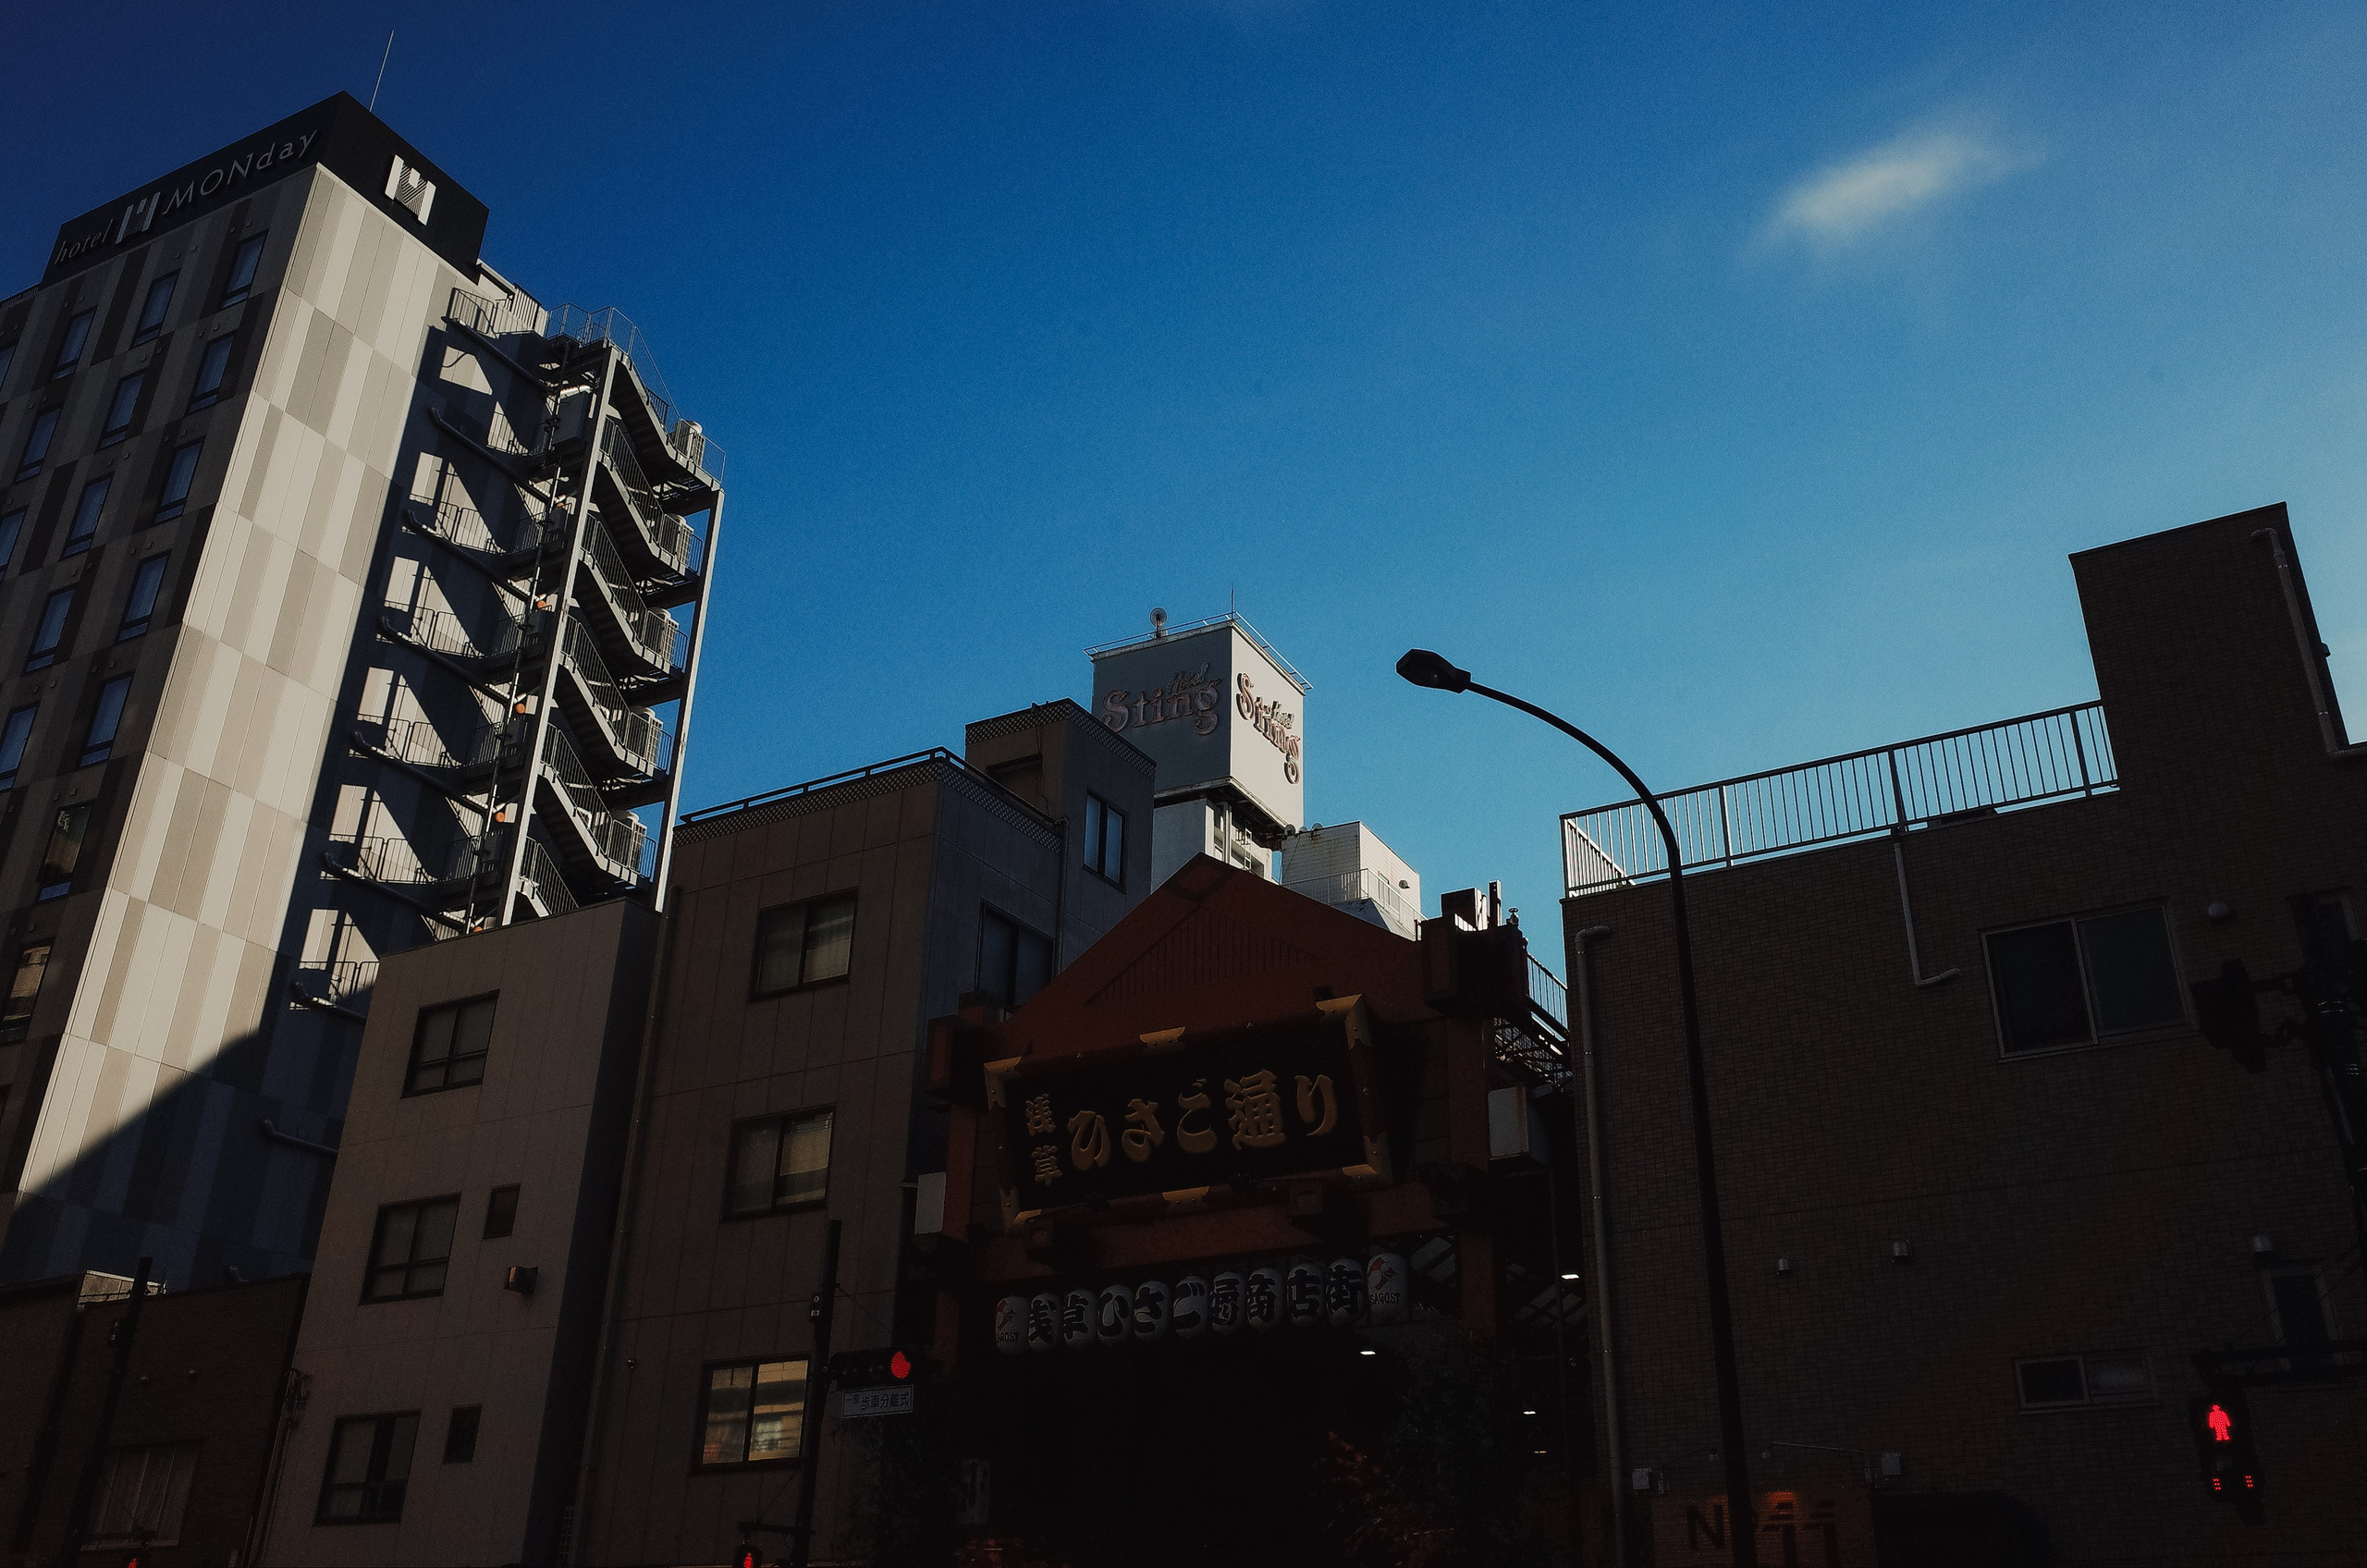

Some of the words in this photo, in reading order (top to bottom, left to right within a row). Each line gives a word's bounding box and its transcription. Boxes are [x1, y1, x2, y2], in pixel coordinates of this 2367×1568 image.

[54, 217, 114, 265] hotel
[162, 129, 317, 215] MONday
[1101, 678, 1223, 735] Sting
[1235, 672, 1301, 784] Sting
[1024, 1092, 1063, 1187] 浅草
[1067, 1069, 1340, 1172] ひさご通り
